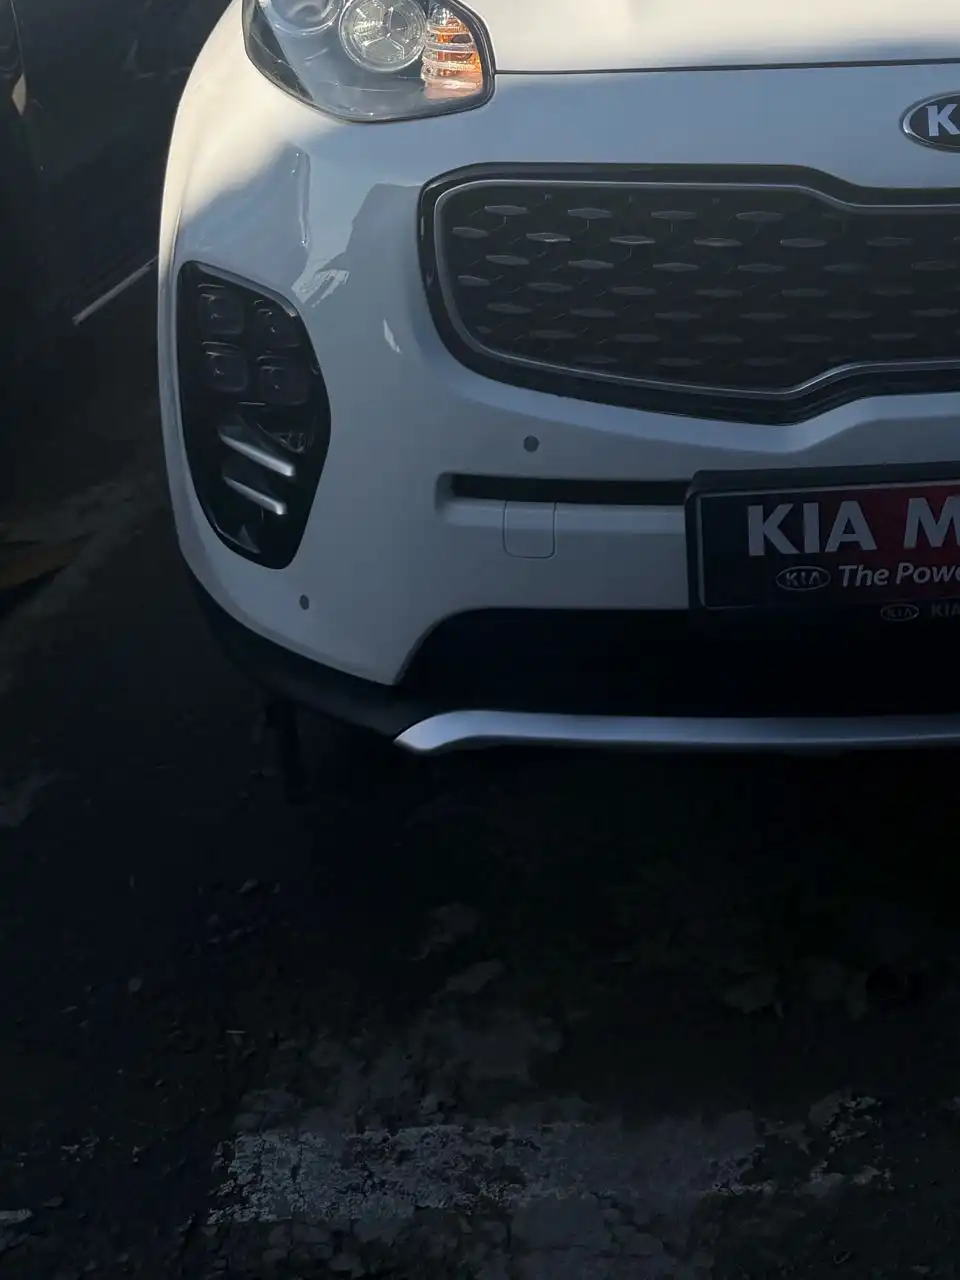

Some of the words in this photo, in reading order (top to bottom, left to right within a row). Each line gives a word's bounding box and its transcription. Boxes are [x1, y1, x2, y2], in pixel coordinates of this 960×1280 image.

[747, 501, 877, 556] KIA
[786, 571, 821, 588] KIA
[839, 563, 889, 587] The
